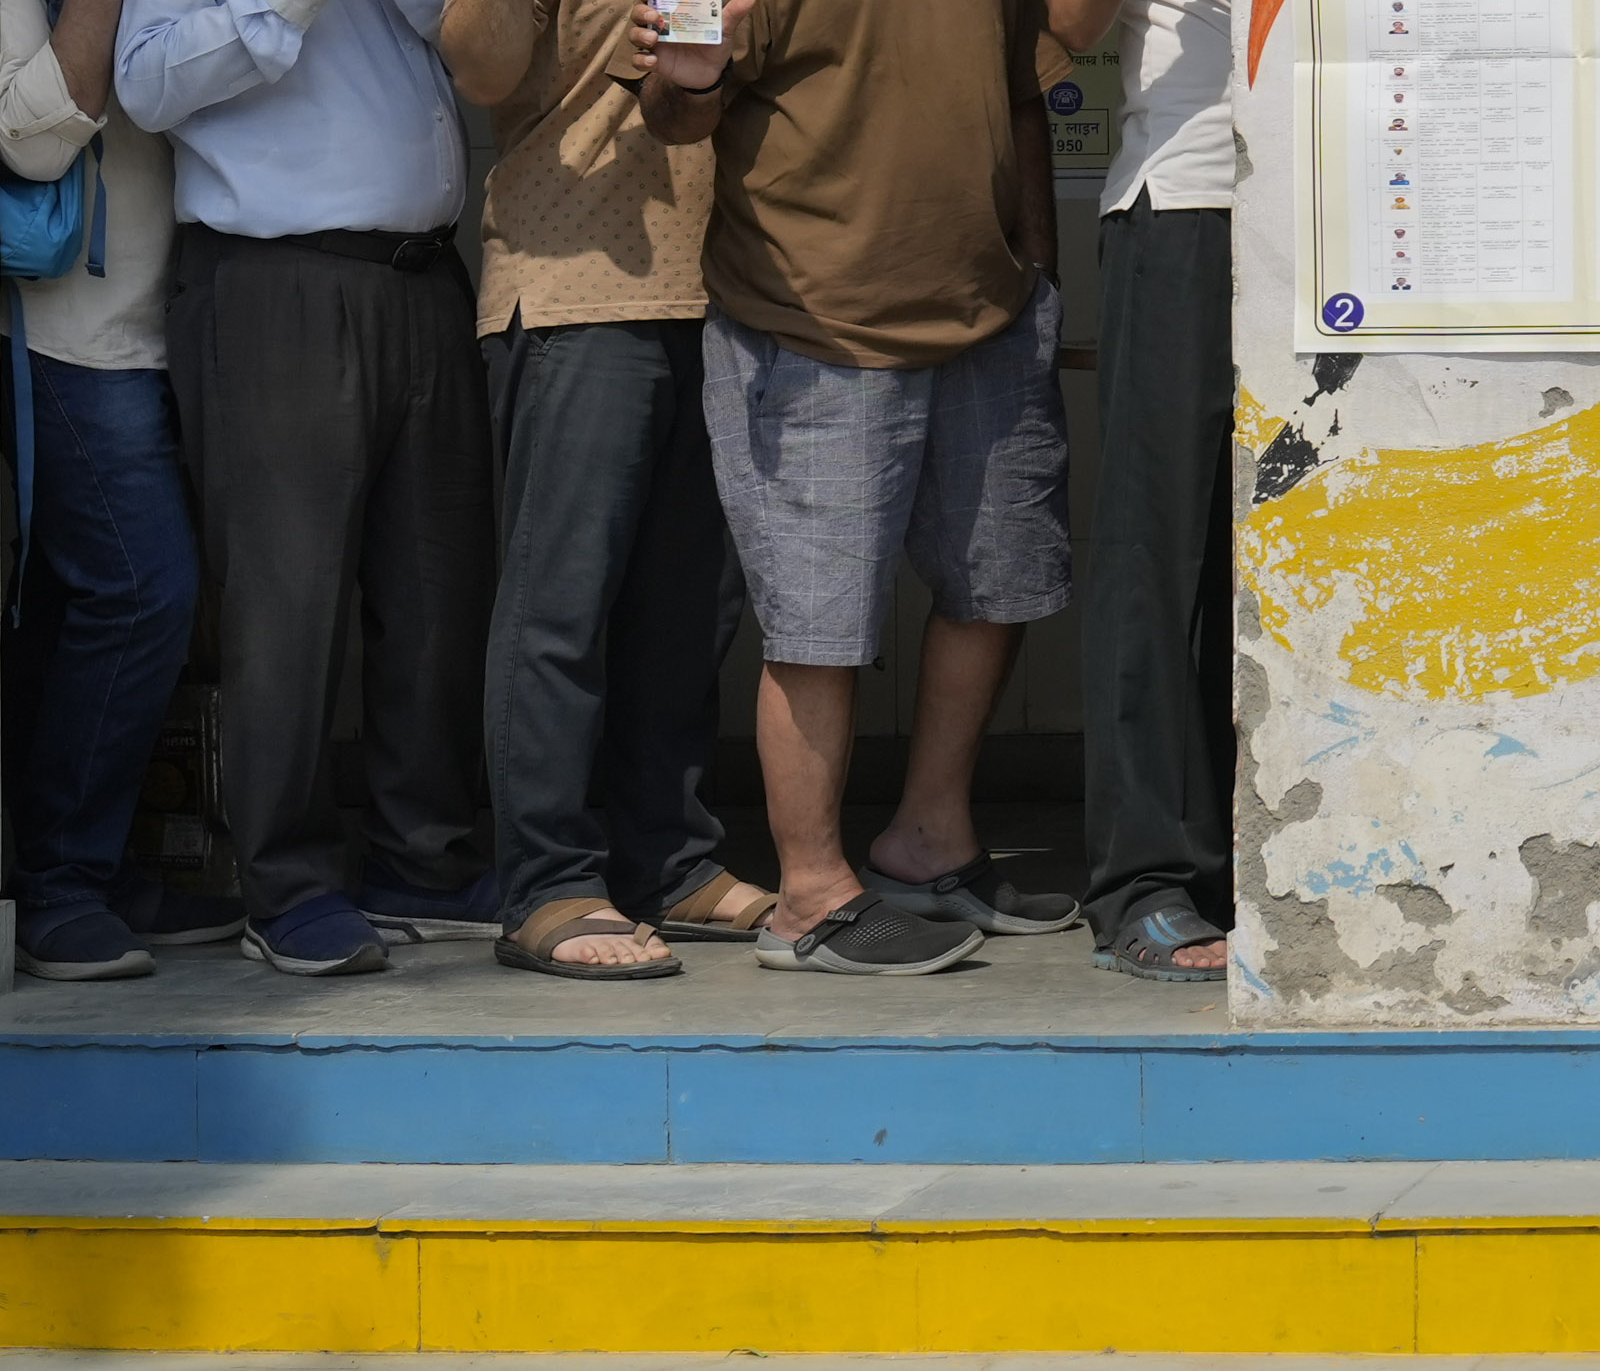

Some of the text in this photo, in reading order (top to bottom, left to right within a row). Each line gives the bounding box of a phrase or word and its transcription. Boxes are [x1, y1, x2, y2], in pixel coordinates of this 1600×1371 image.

[1064, 122, 1100, 138] लाइन
[1333, 298, 1355, 328] 2
[826, 910, 859, 922] RIDE
